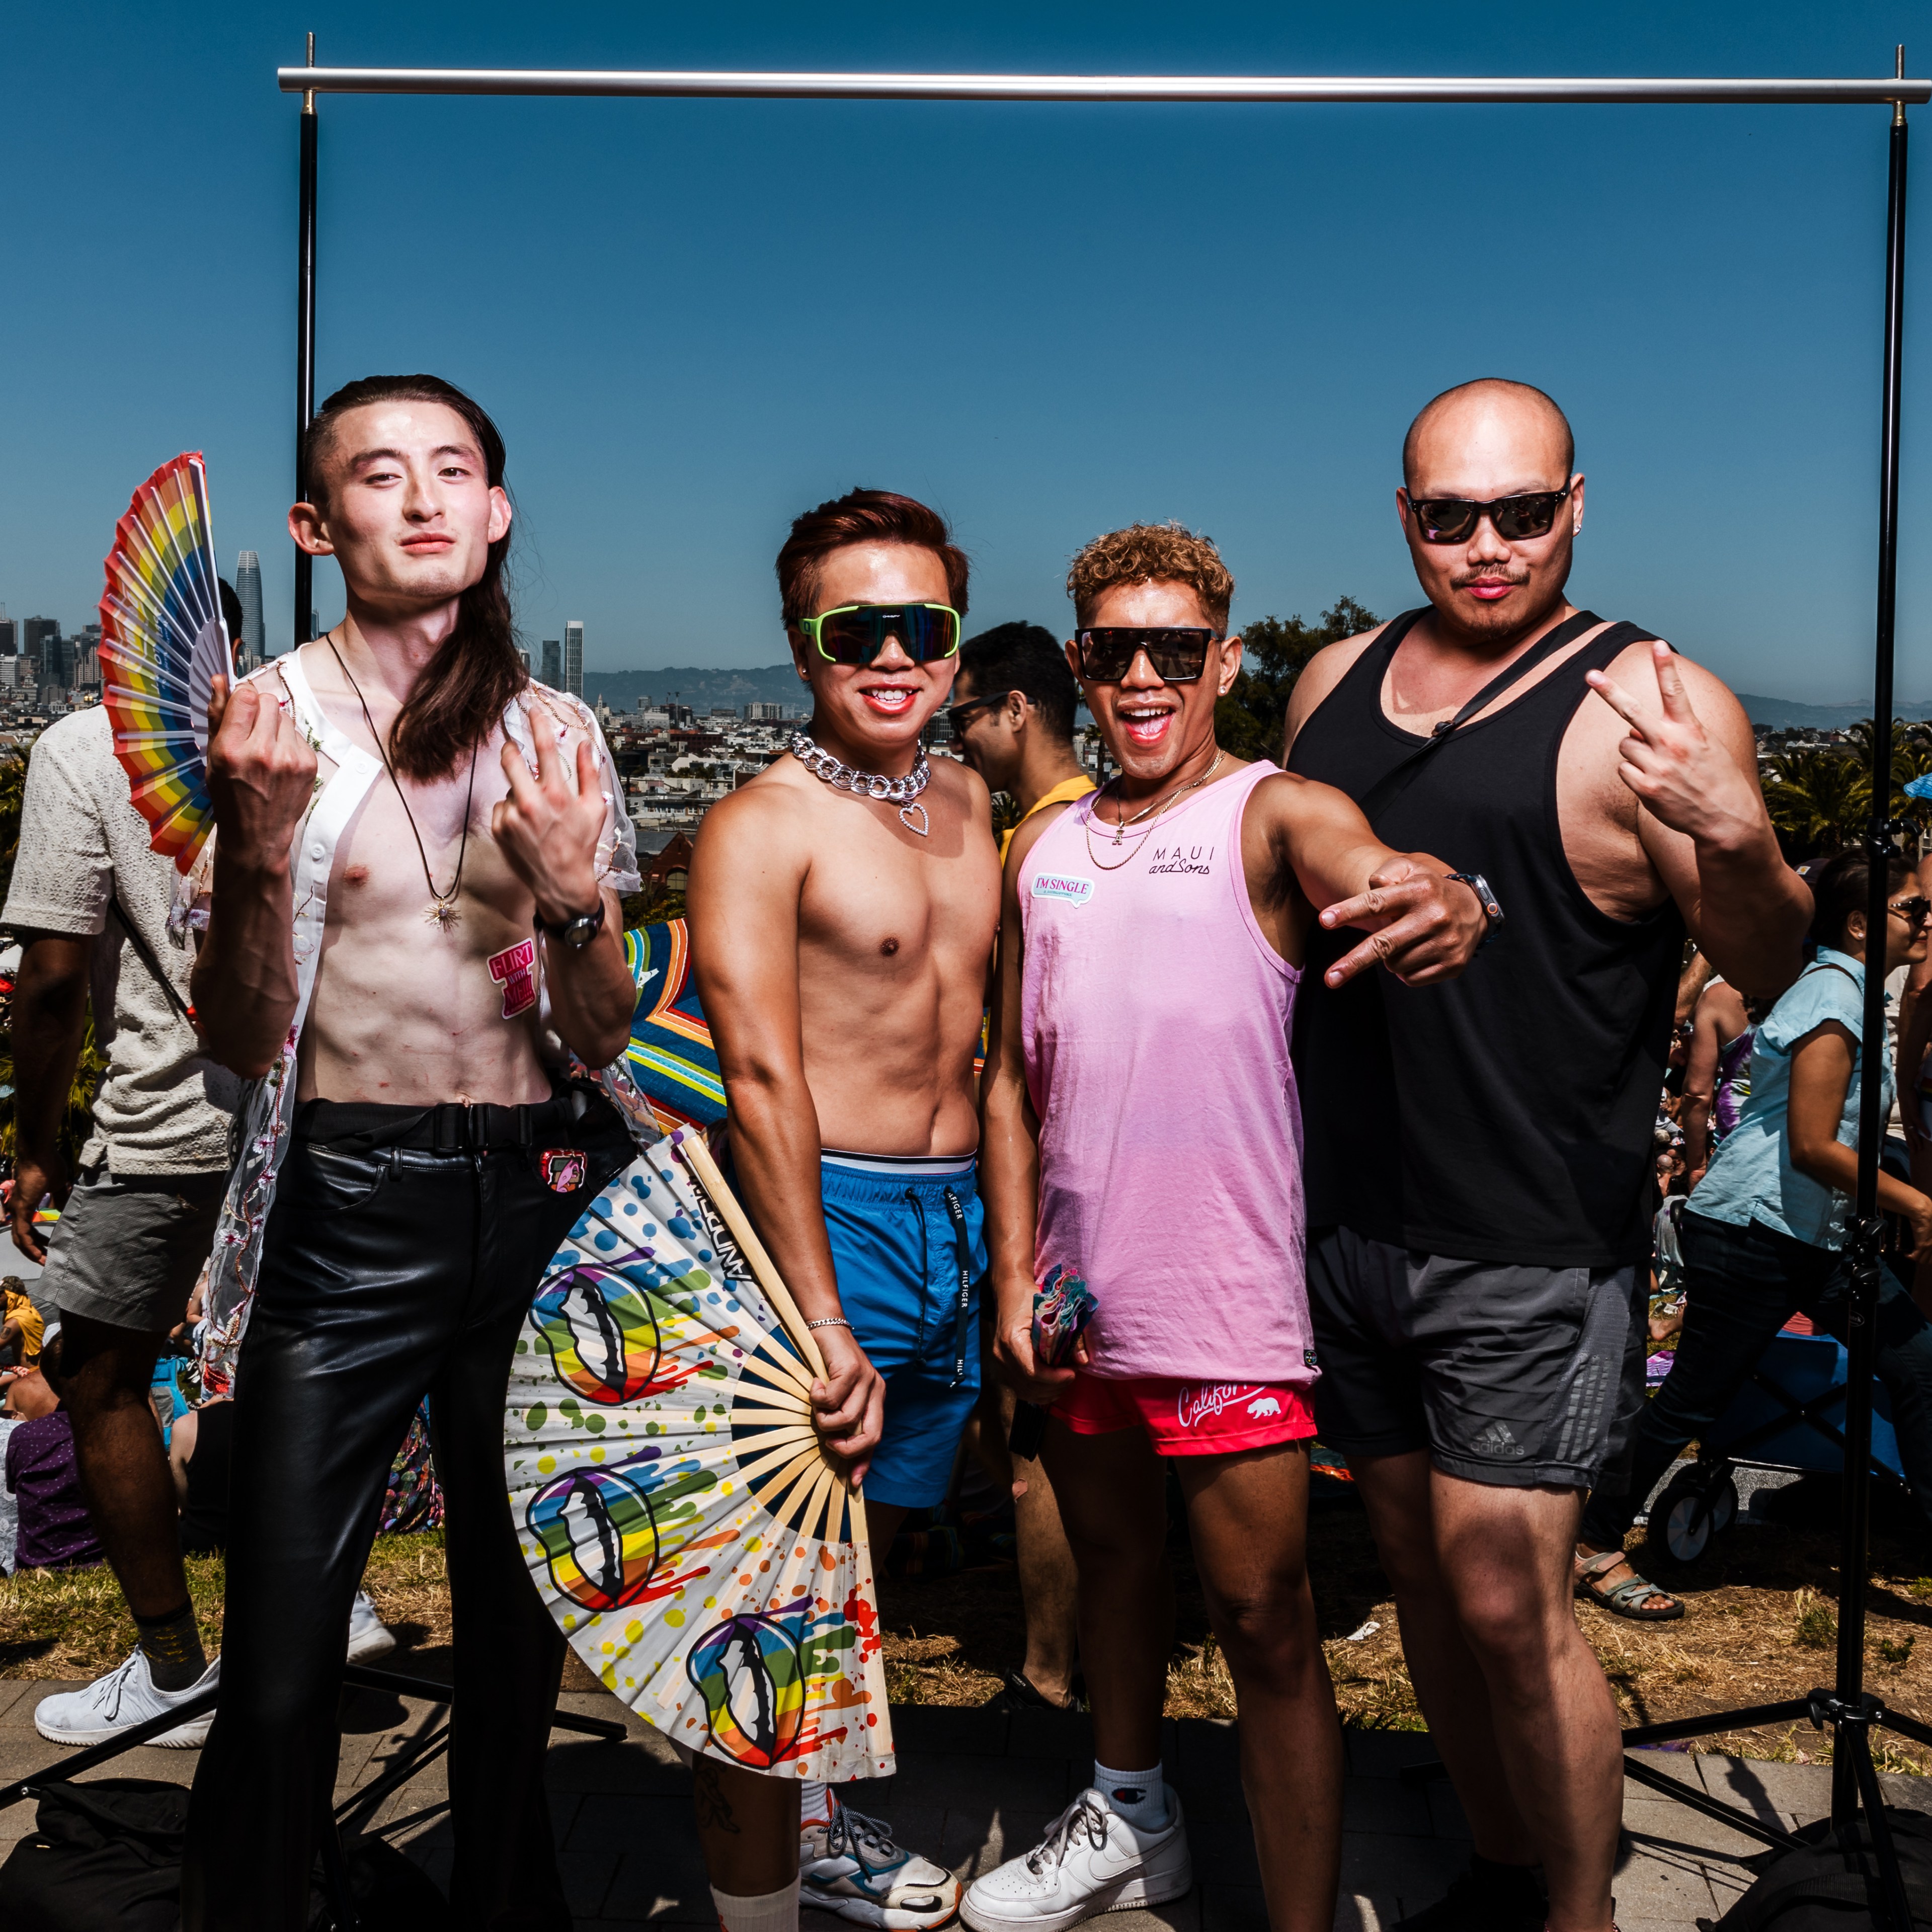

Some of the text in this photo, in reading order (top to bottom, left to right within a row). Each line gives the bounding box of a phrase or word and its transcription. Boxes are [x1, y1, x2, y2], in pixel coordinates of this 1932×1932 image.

[1153, 846, 1215, 861] MAUI
[1035, 877, 1050, 889] I'M
[1050, 878, 1089, 895] SINGLE
[491, 943, 531, 978] FLIRT
[507, 968, 526, 985] WITH
[505, 977, 532, 1007] ME!!!
[1470, 1441, 1525, 1456] adidas
